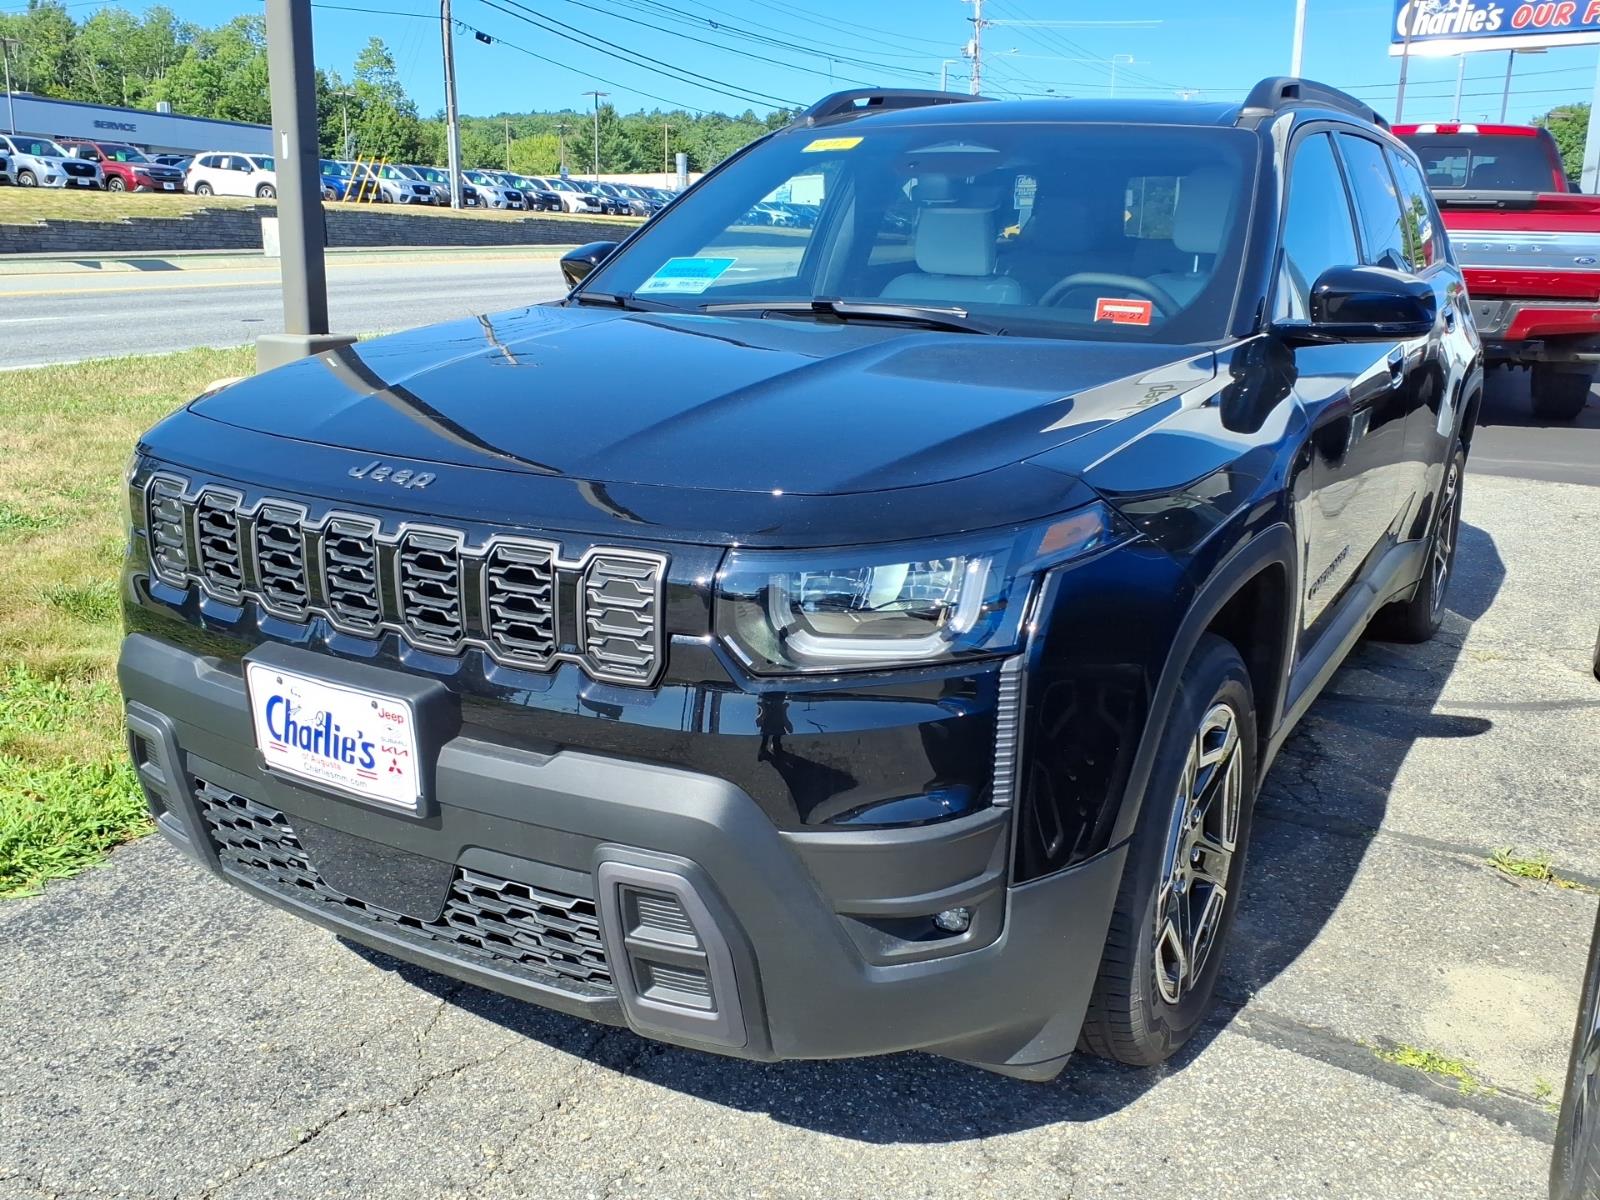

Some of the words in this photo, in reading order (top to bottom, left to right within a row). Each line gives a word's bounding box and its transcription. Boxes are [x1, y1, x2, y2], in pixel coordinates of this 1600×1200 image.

[1396, 0, 1504, 37] Charlie's
[1511, 3, 1577, 29] OUR
[1582, 0, 1600, 24] F
[94, 120, 137, 132] SERVICE
[1128, 312, 1143, 320] 27
[348, 460, 437, 490] Jeep
[378, 707, 404, 725] Jeep
[266, 694, 376, 770] Charlie's
[303, 762, 368, 789] Charliesmm.com
[311, 754, 342, 771] Augusta
